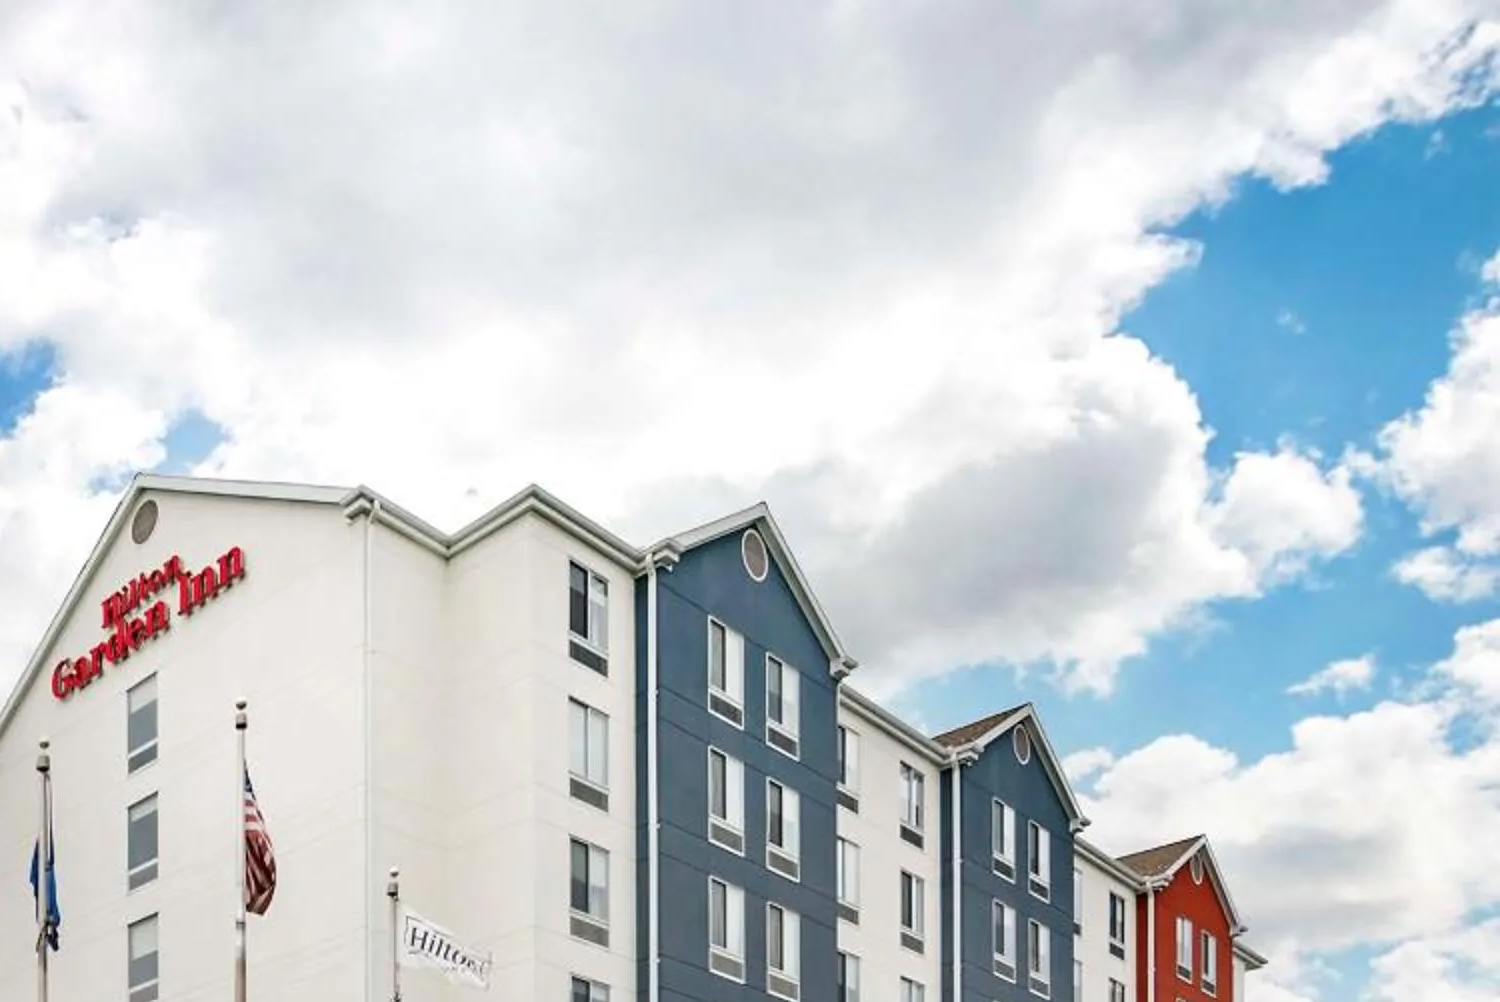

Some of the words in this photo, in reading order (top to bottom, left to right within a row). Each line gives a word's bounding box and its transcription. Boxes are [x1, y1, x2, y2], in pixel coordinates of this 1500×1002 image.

[51, 600, 169, 700] Garden
[177, 546, 246, 618] Inn
[101, 555, 184, 628] Hilton
[410, 926, 477, 971] Hilton
